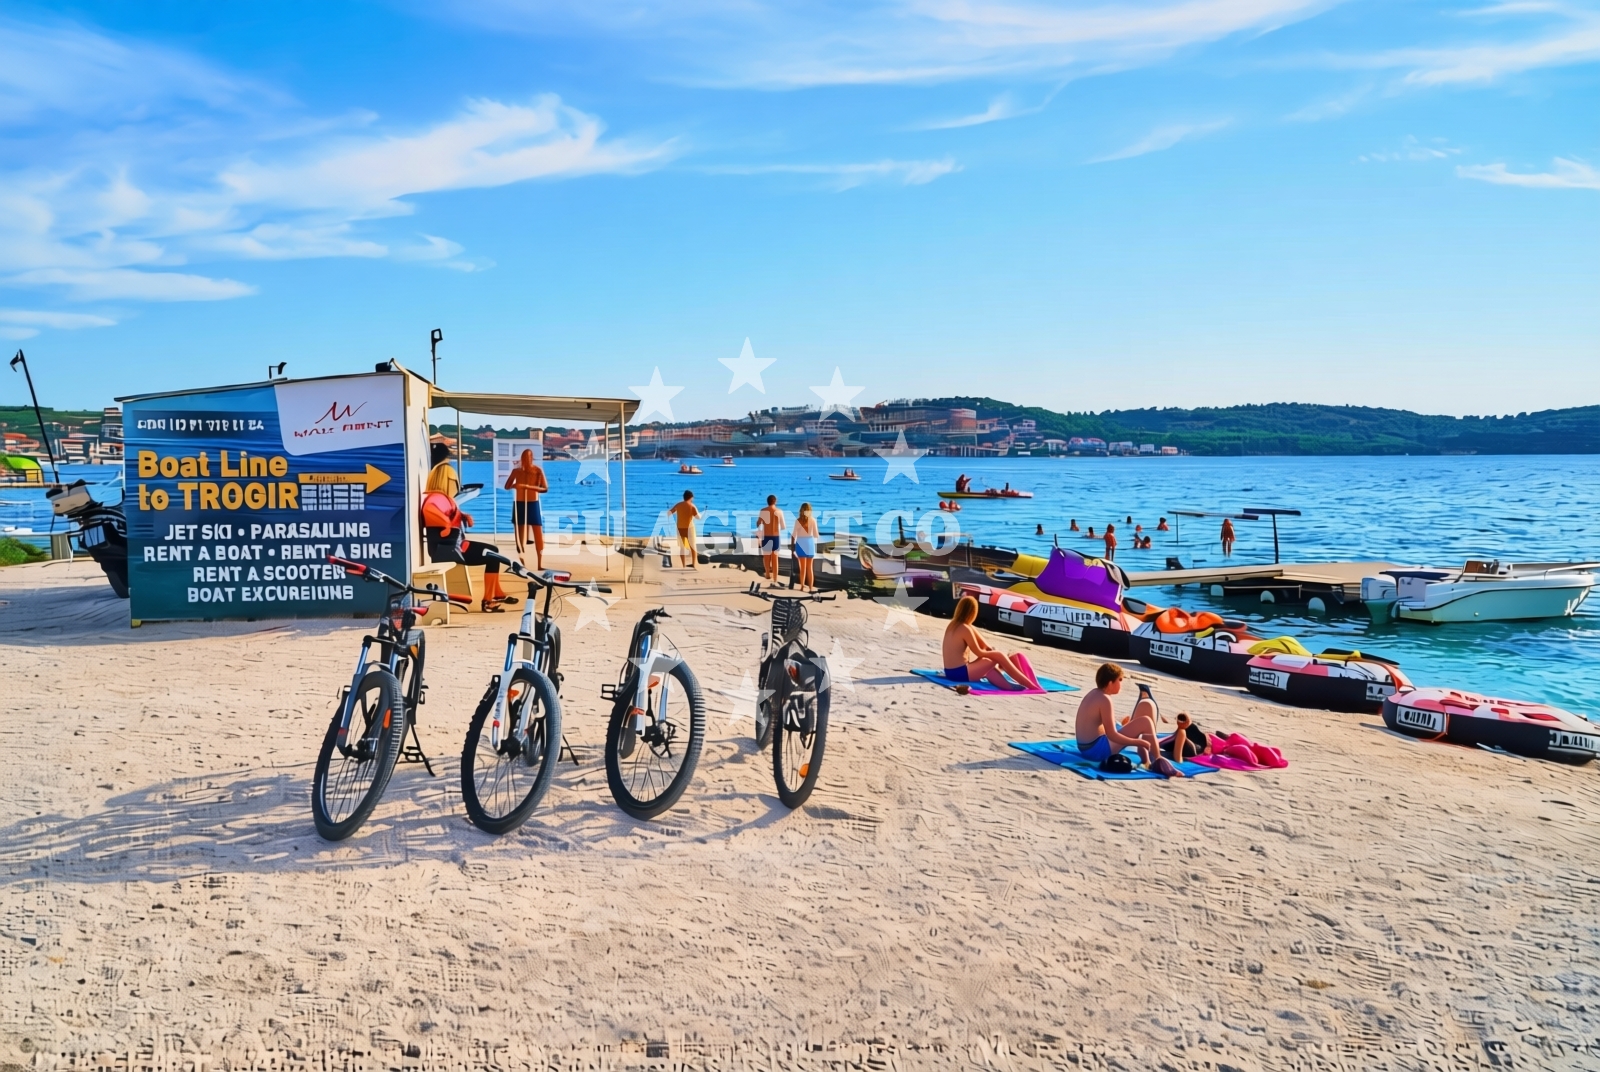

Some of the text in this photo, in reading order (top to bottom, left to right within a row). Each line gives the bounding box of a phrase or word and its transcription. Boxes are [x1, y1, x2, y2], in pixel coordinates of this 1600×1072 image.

[138, 450, 288, 478] Boat Line
[138, 483, 169, 511] to
[177, 481, 299, 510] TROGIR
[164, 524, 198, 540] JET
[143, 545, 194, 562] RENT
[197, 545, 212, 561] A
[215, 544, 263, 561] BOAT
[193, 566, 242, 583] RENT
[246, 566, 261, 582] A
[187, 586, 236, 603] BOAT
